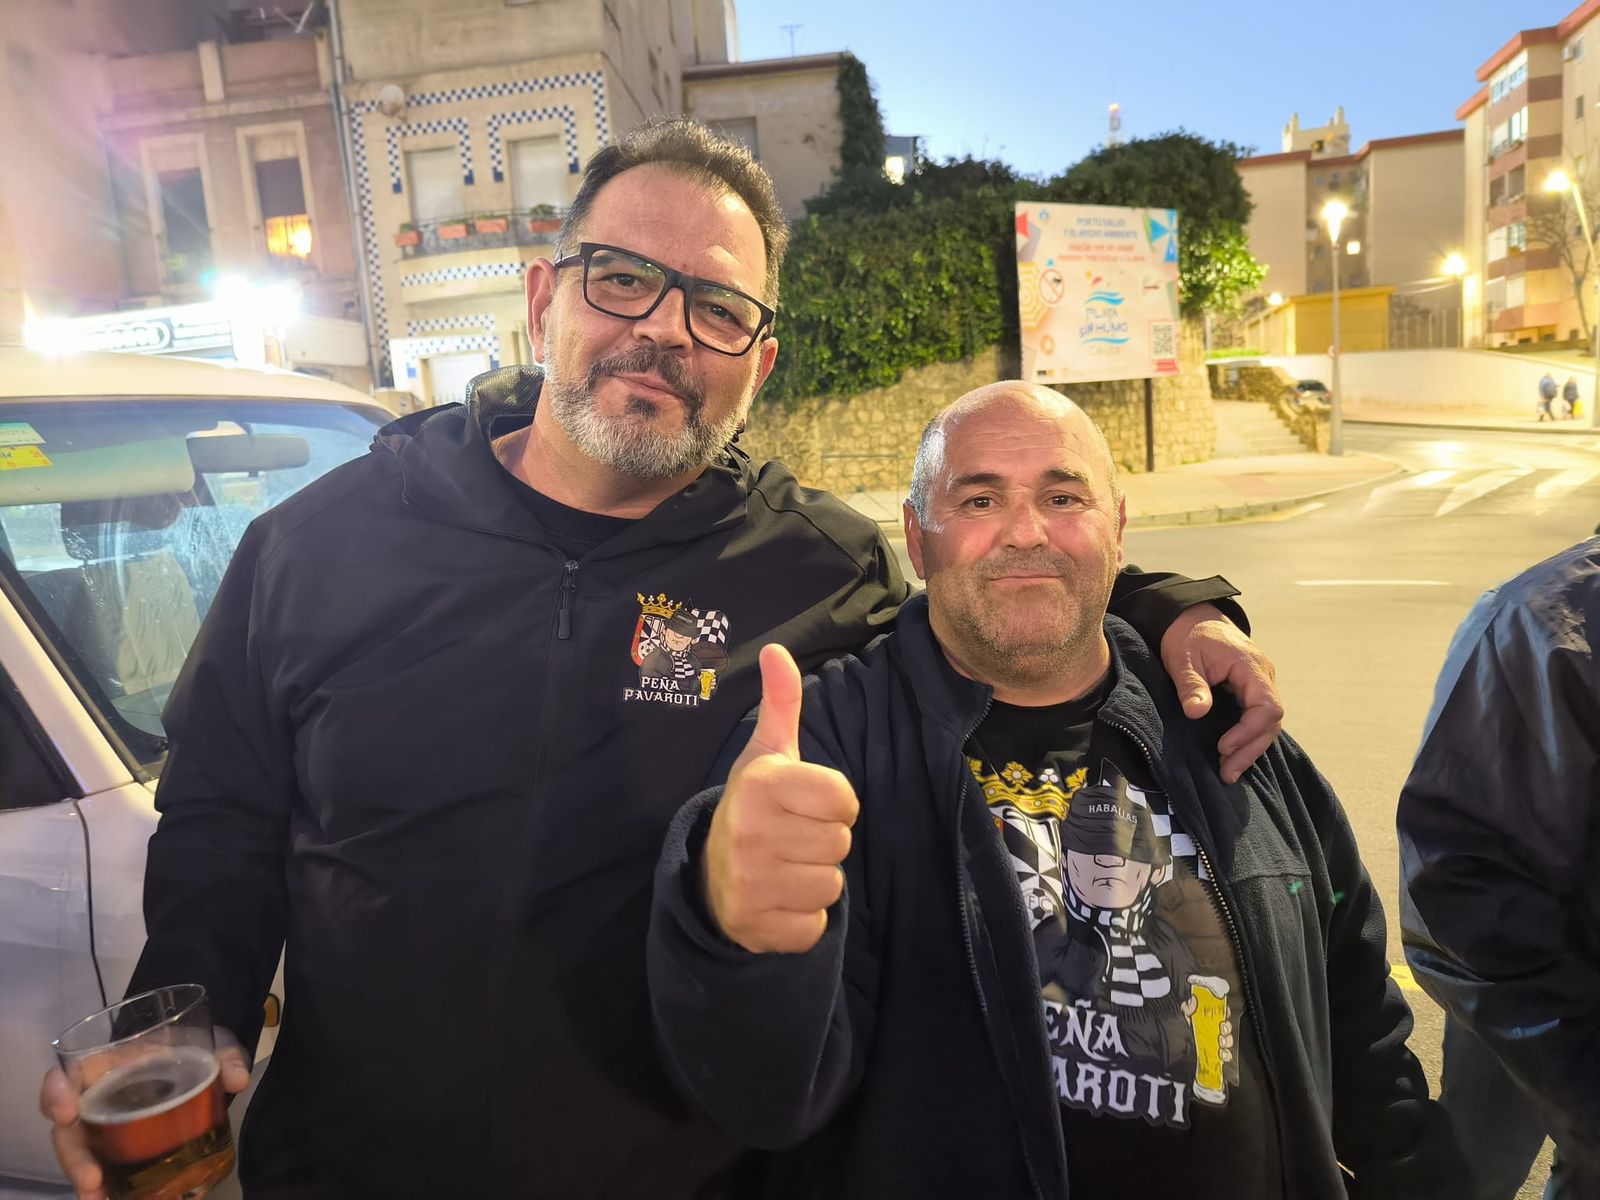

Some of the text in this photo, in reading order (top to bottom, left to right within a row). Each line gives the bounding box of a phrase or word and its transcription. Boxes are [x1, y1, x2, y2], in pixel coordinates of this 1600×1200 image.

[1095, 322, 1128, 335] HUMO
[641, 676, 680, 693] PEÑA
[624, 688, 698, 706] PAVAROTI
[1042, 999, 1129, 1062] EÑA
